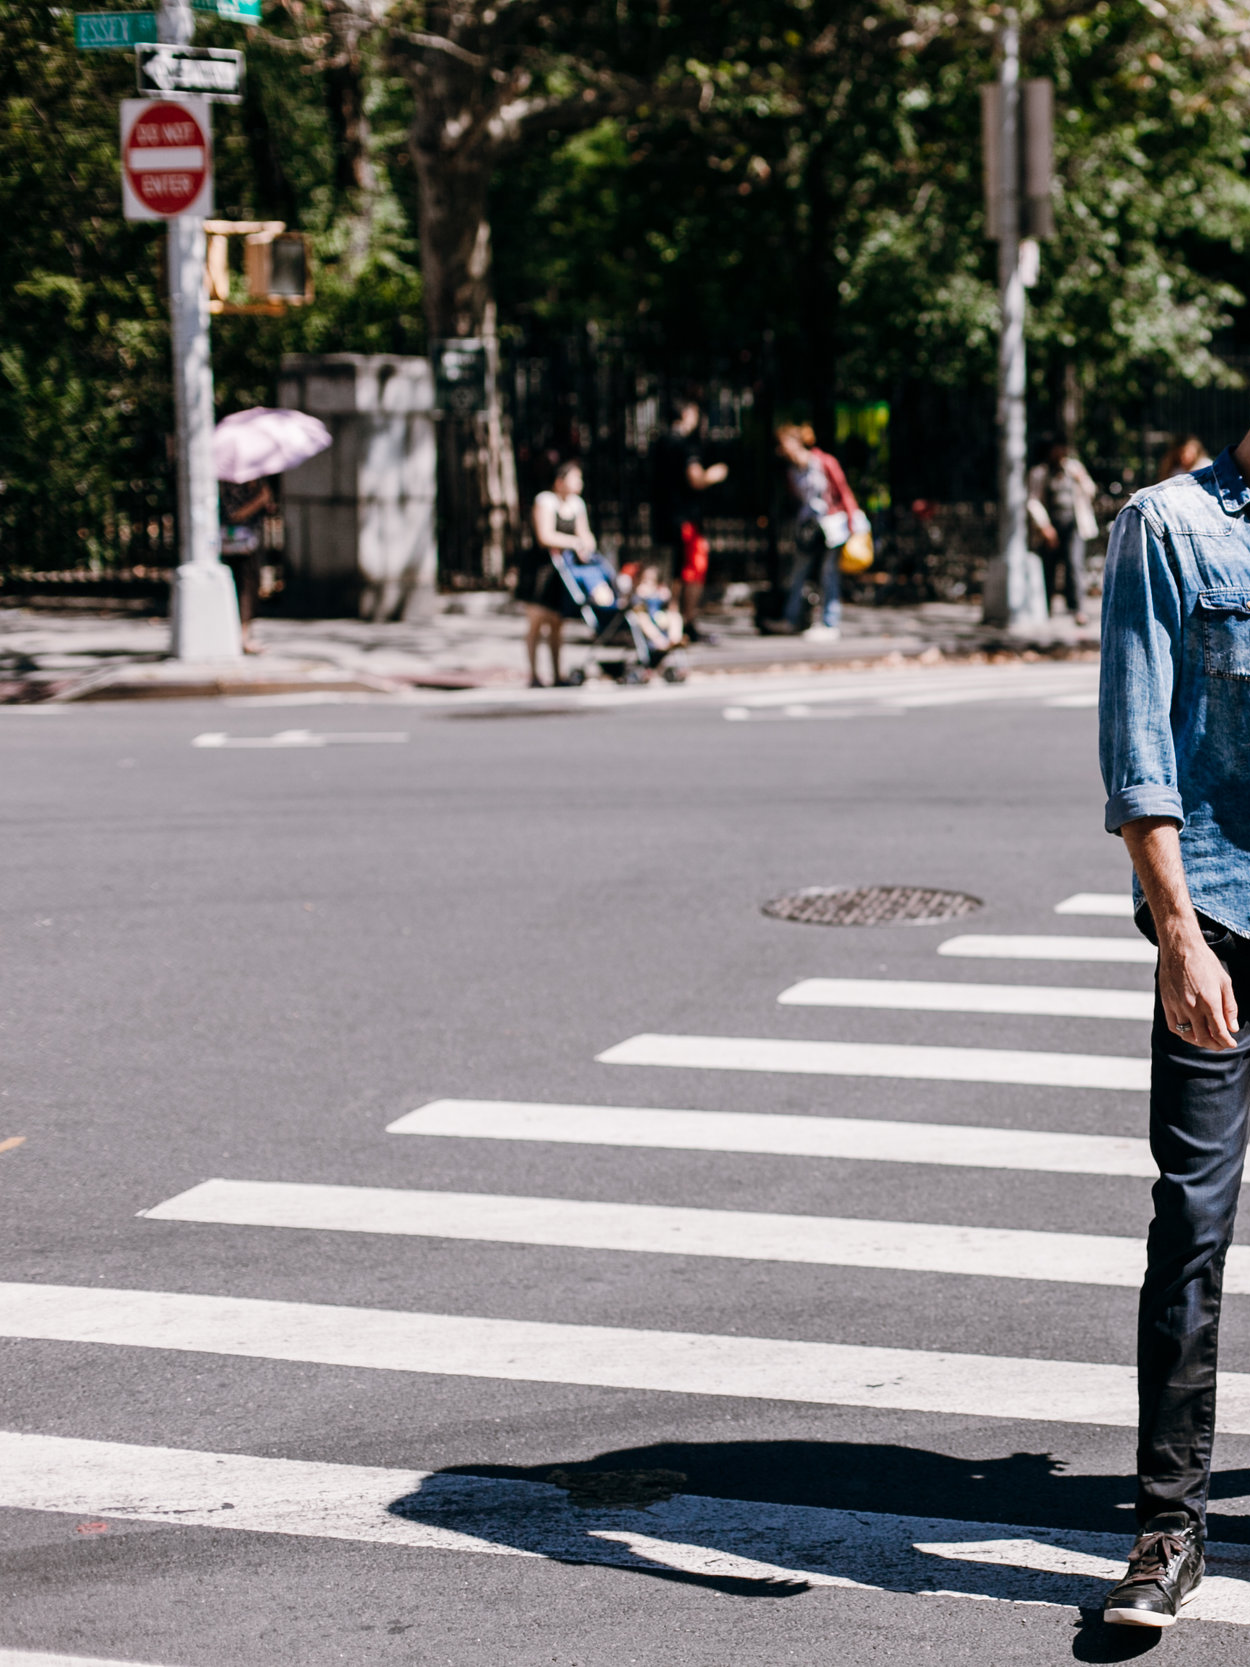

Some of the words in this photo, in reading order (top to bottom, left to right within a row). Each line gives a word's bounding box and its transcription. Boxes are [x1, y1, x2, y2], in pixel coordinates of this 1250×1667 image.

[136, 122, 159, 145] DO
[161, 121, 195, 145] NOT
[141, 174, 195, 199] ENTER
